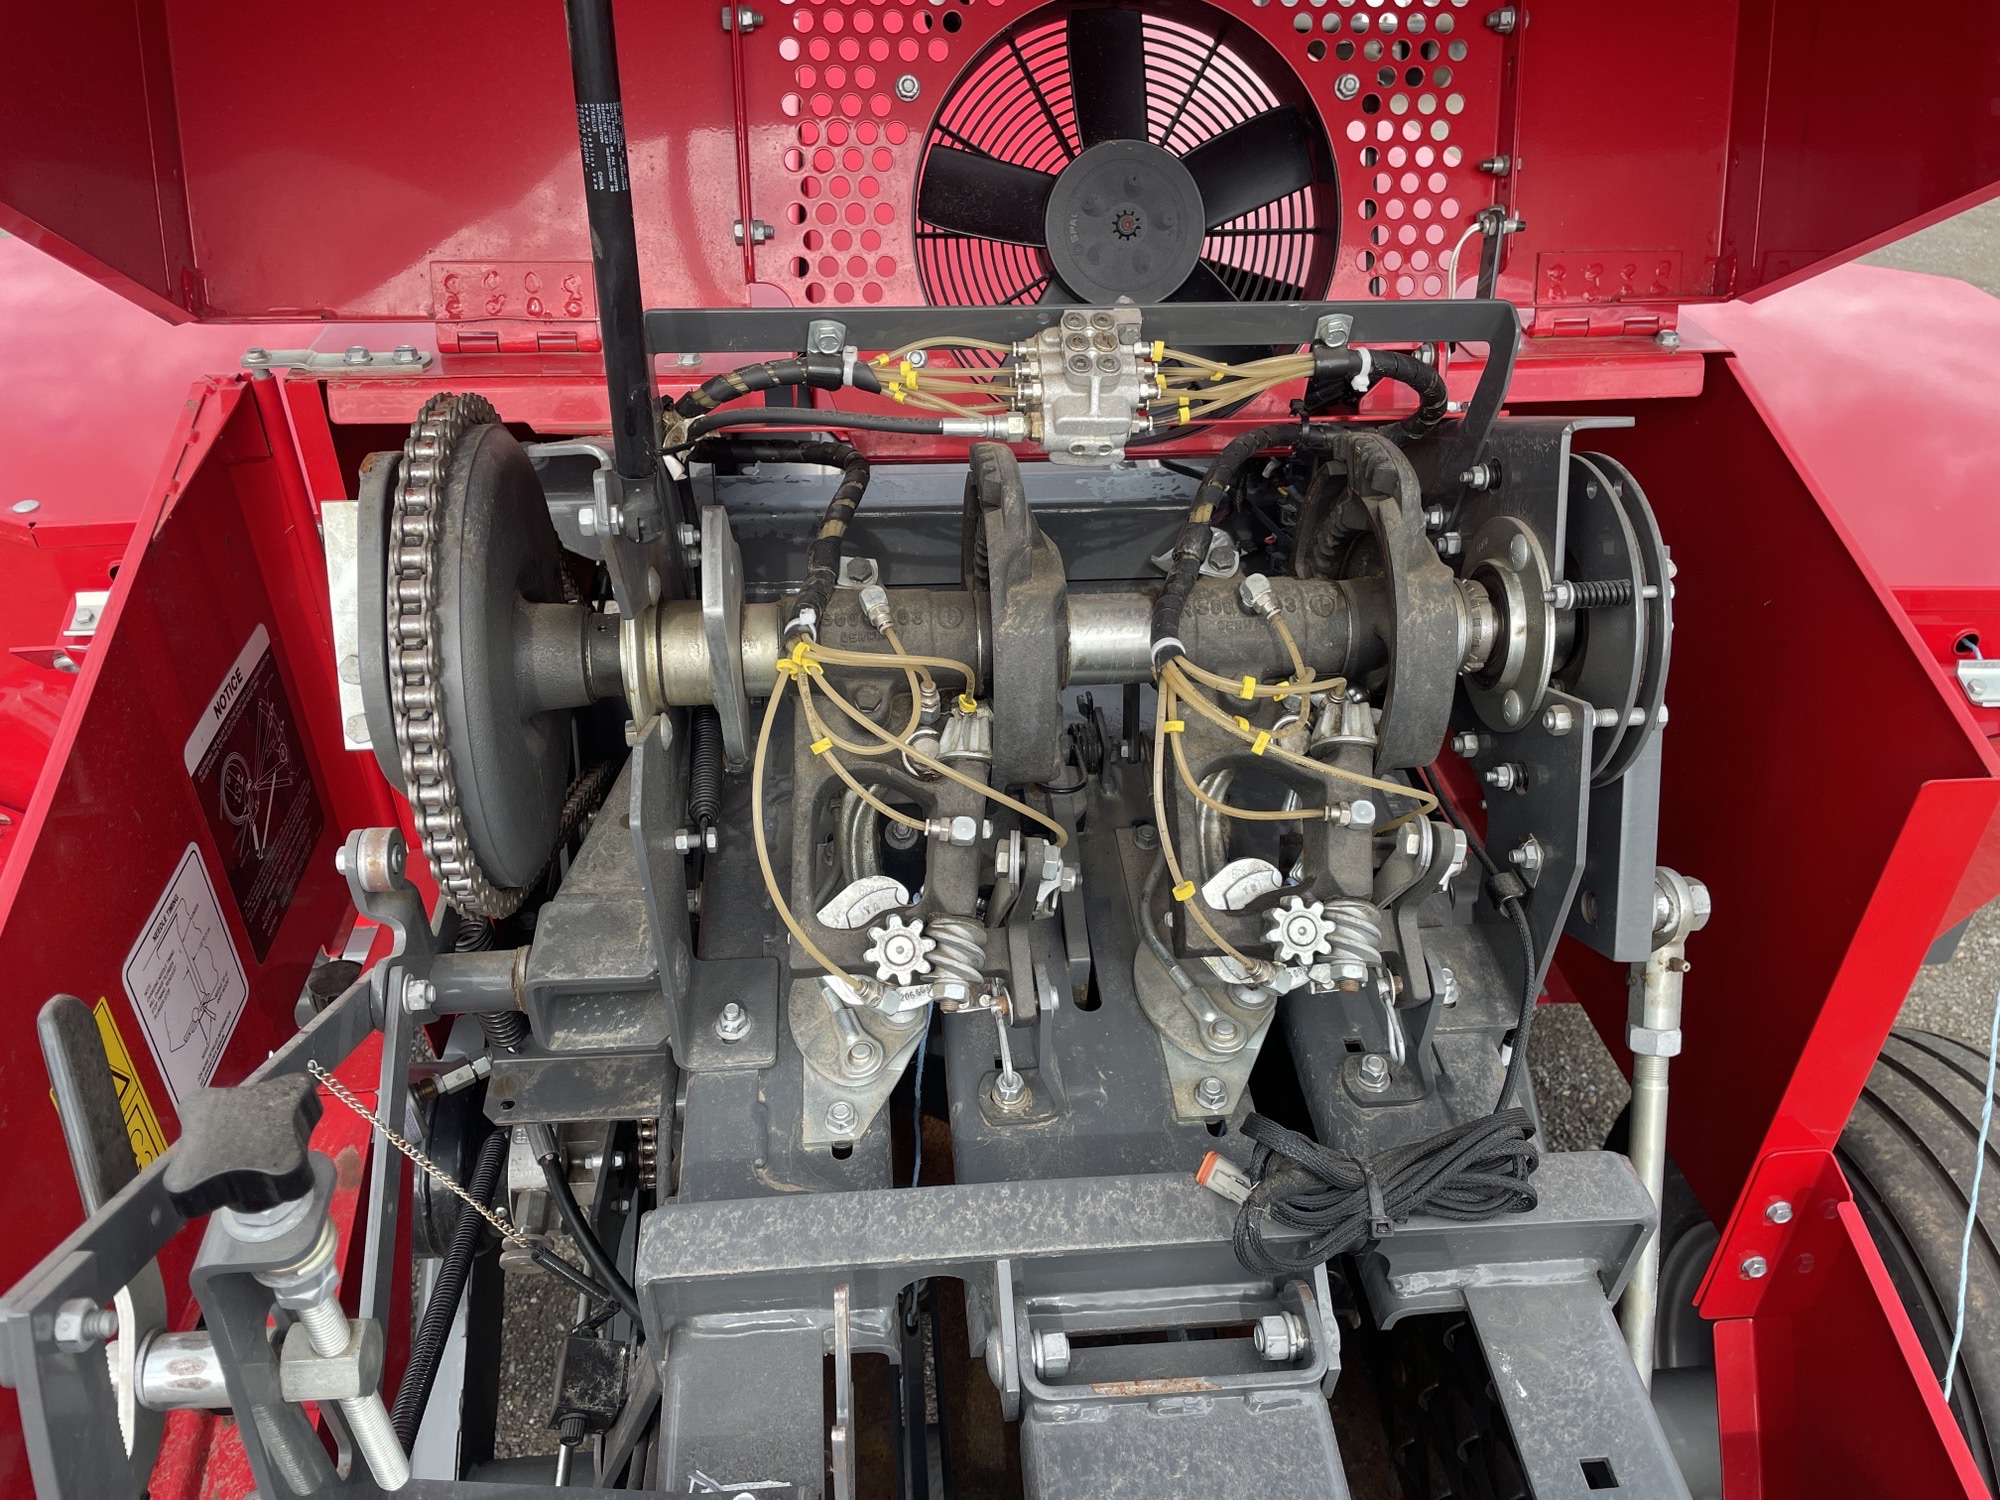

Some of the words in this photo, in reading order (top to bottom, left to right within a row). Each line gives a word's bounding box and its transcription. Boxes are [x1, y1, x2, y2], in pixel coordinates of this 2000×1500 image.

[1069, 210, 1079, 243] SPAL
[212, 664, 243, 721] NOTICE
[152, 913, 167, 943] NEEDLE
[166, 891, 179, 918] TIMING
